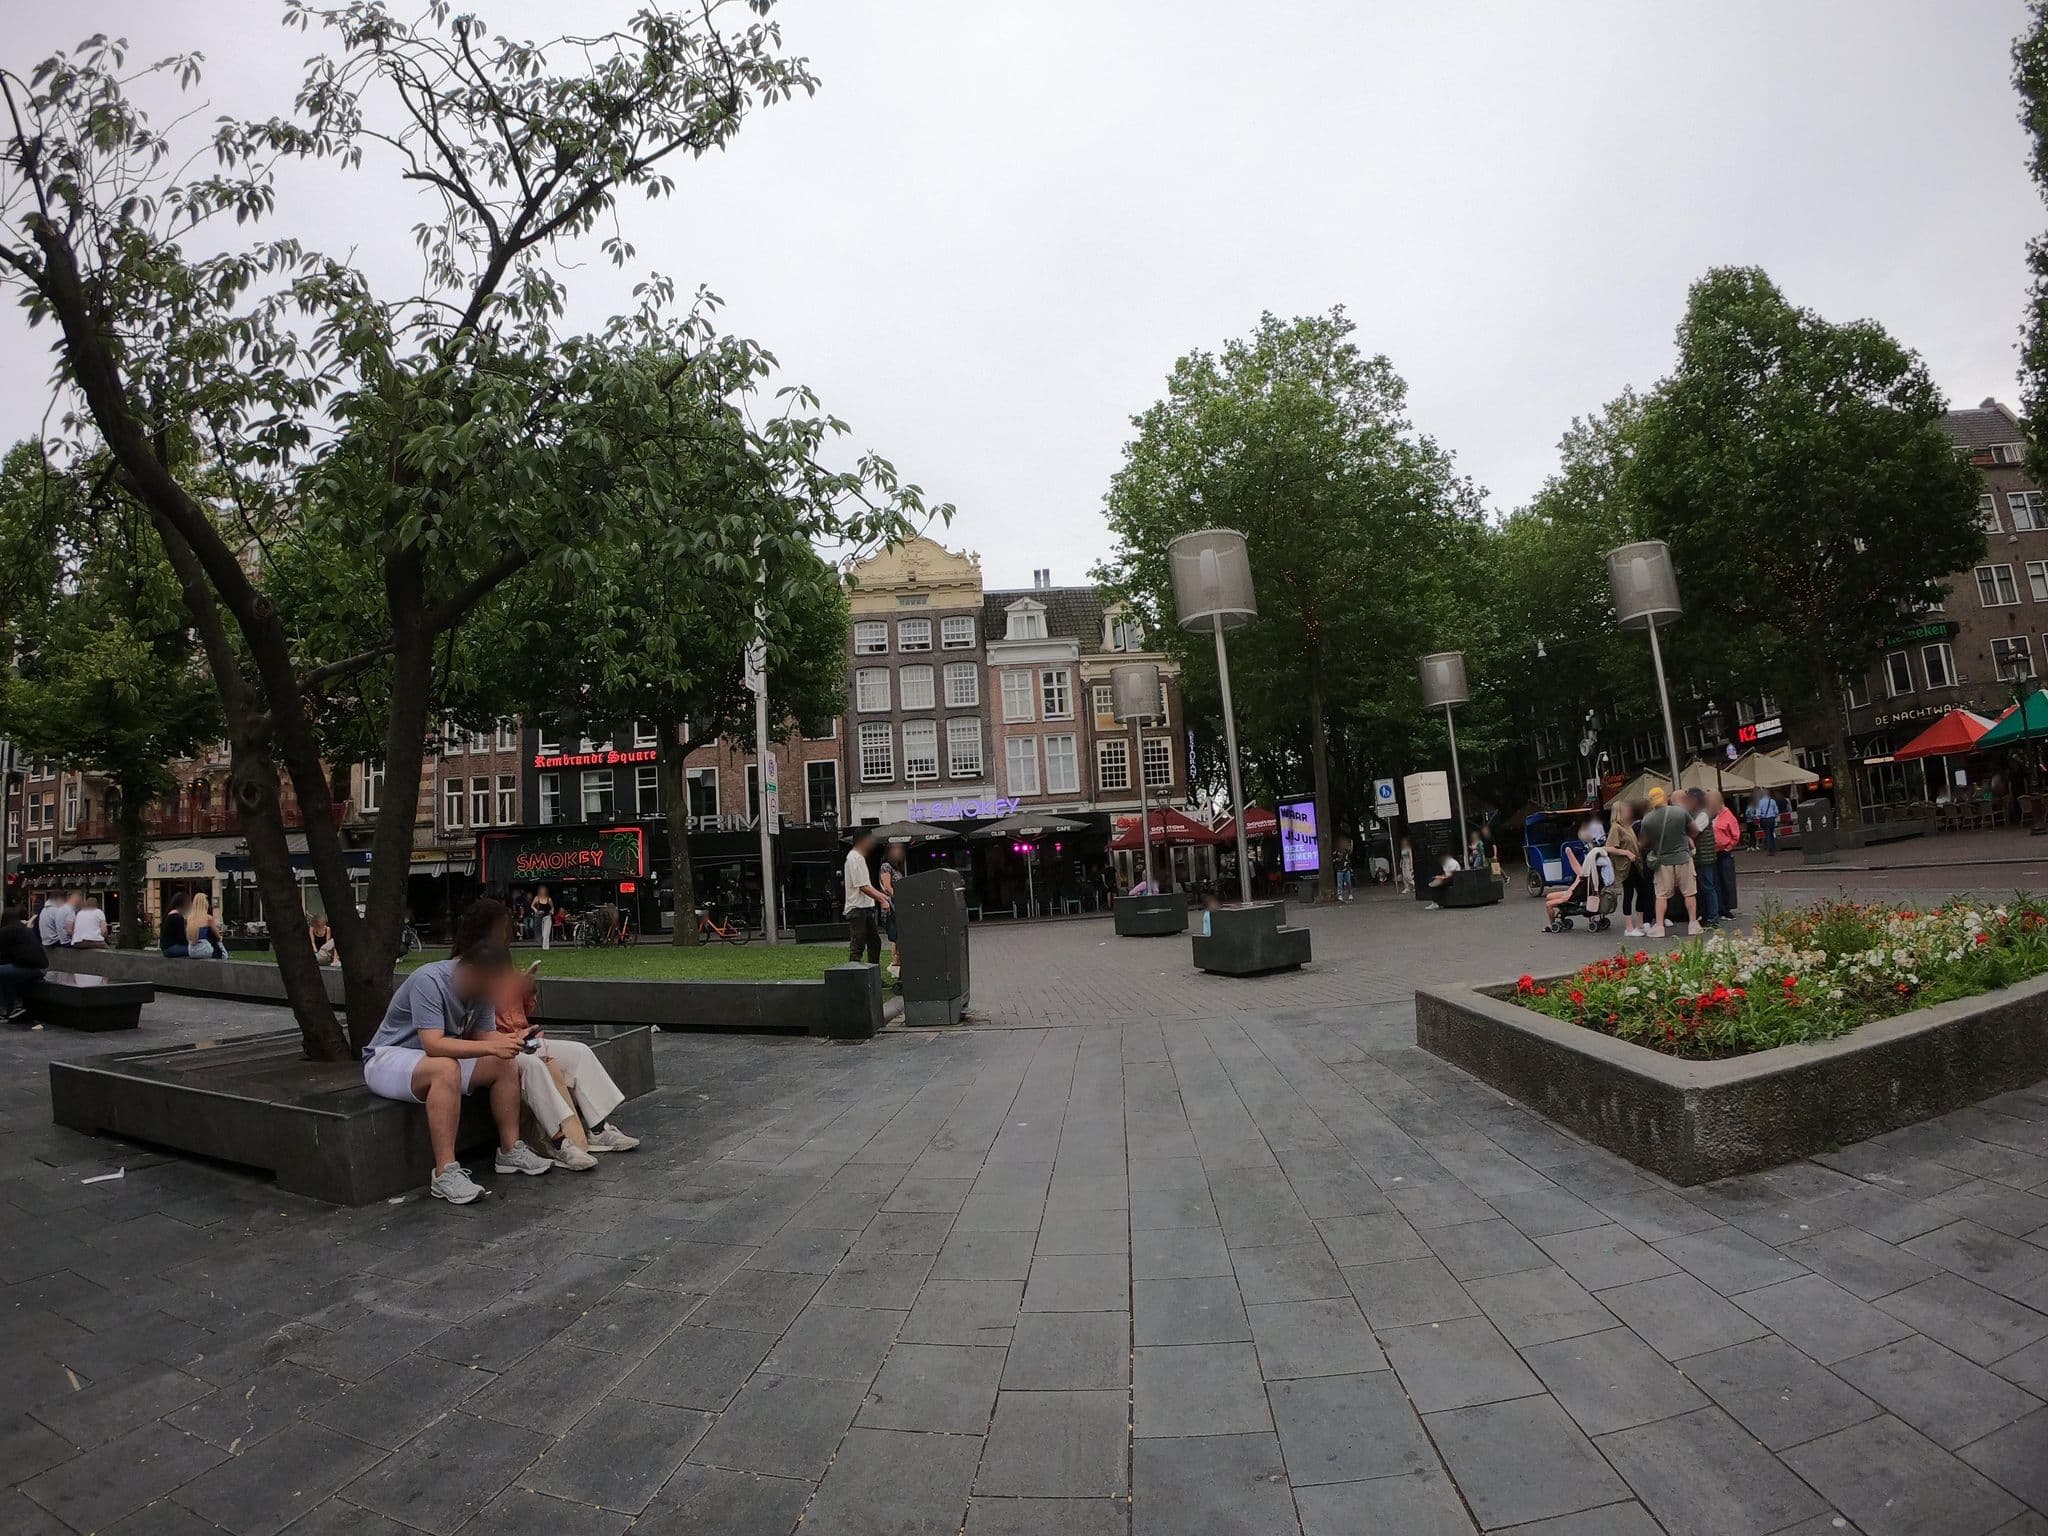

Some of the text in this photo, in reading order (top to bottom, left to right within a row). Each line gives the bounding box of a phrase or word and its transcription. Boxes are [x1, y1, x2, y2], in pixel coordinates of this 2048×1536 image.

[1875, 700, 1975, 726] DE NACHTWAT
[1739, 725, 1757, 743] K2
[534, 750, 657, 768] Rembrandt Square
[931, 797, 1020, 819] SMOKEY
[1280, 808, 1308, 822] WAAR
[1285, 831, 1318, 845] JIJ UIT
[1285, 845, 1306, 853] DEZE
[170, 862, 205, 872] SCHILLER
[516, 850, 604, 871] SMOKEY
